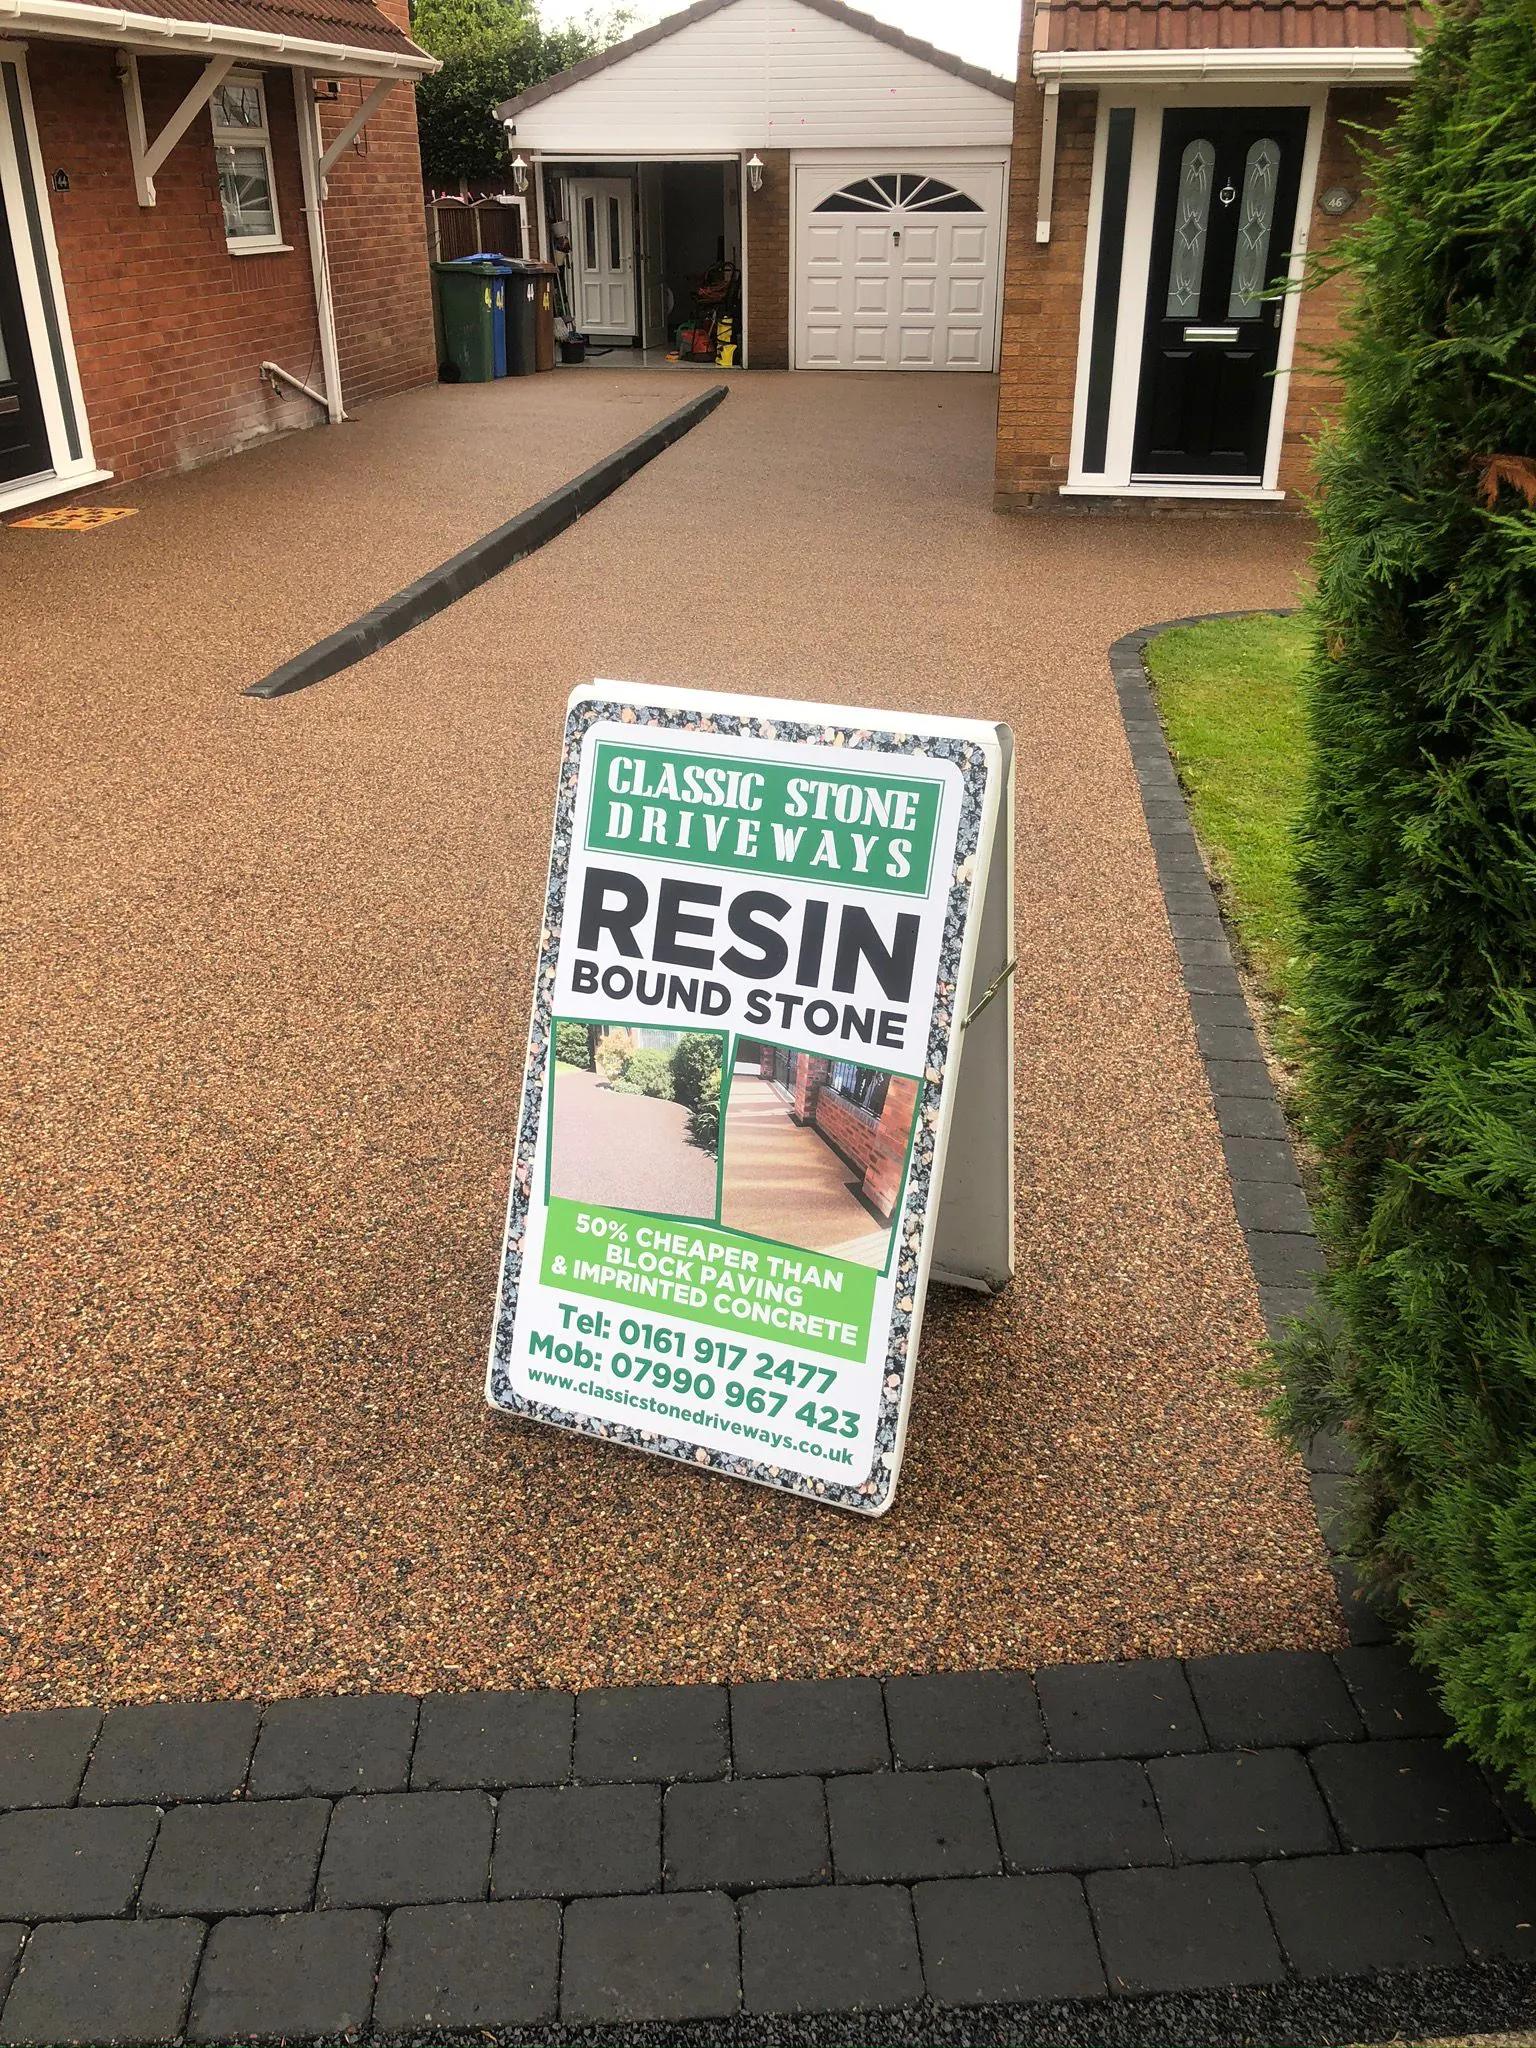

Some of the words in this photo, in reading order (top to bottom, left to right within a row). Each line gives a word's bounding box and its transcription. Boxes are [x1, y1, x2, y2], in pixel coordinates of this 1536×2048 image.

[1328, 197, 1343, 208] 46
[607, 756, 766, 812] CLASSIC
[784, 778, 920, 831] STONE
[605, 801, 912, 879] DRIVEWAYS
[577, 867, 921, 1003] RESIN
[571, 959, 732, 1017] BOUND
[743, 988, 908, 1050] STONE
[575, 1213, 629, 1243] 50%
[635, 1227, 758, 1273] CHEAPER
[766, 1256, 843, 1293] THAN
[606, 1243, 693, 1282] BLOCK
[699, 1265, 804, 1307] PAVING
[550, 1255, 568, 1276] &
[572, 1259, 707, 1309] IMPRINTED
[713, 1294, 859, 1346] CONCRETE
[528, 1331, 602, 1372] Mob:
[610, 1352, 716, 1400] 07990
[724, 1380, 788, 1418] 967
[795, 1400, 861, 1439] 423
[557, 1302, 611, 1340] Tel:
[618, 1318, 686, 1358] 0161
[693, 1337, 748, 1371] 917
[753, 1352, 838, 1395] 2477
[527, 1368, 854, 1466] www.classicstonedriveways.co.uk
